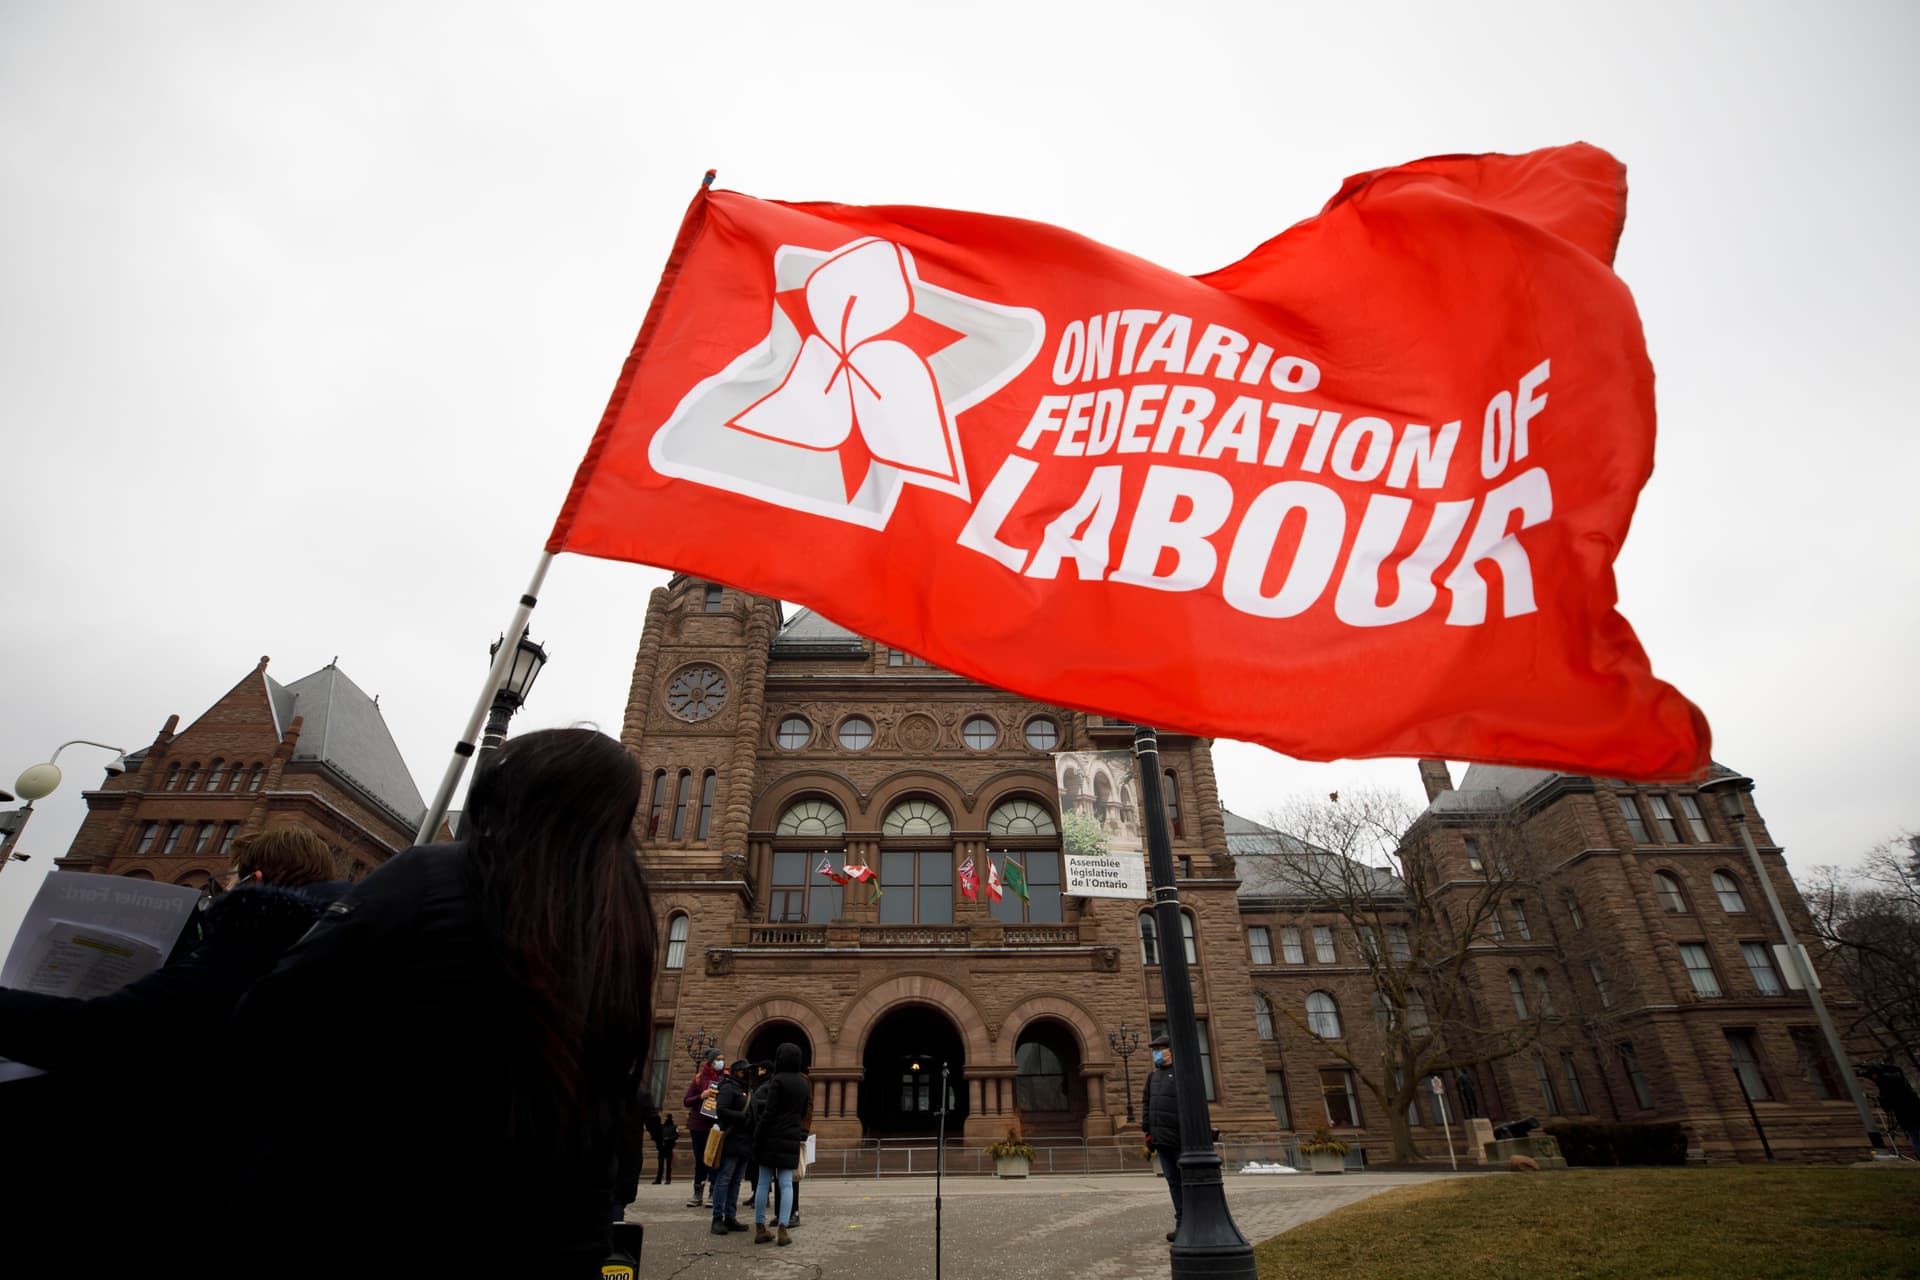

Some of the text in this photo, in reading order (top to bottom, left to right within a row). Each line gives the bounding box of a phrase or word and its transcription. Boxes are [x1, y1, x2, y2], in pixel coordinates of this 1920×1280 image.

[1052, 308, 1321, 393] ONTARIO
[1016, 359, 1550, 489] FEDERATION OF
[956, 453, 1553, 628] LABOUR
[1070, 858, 1121, 868] Assemblée
[1070, 867, 1119, 878] législative
[1071, 877, 1084, 887] de
